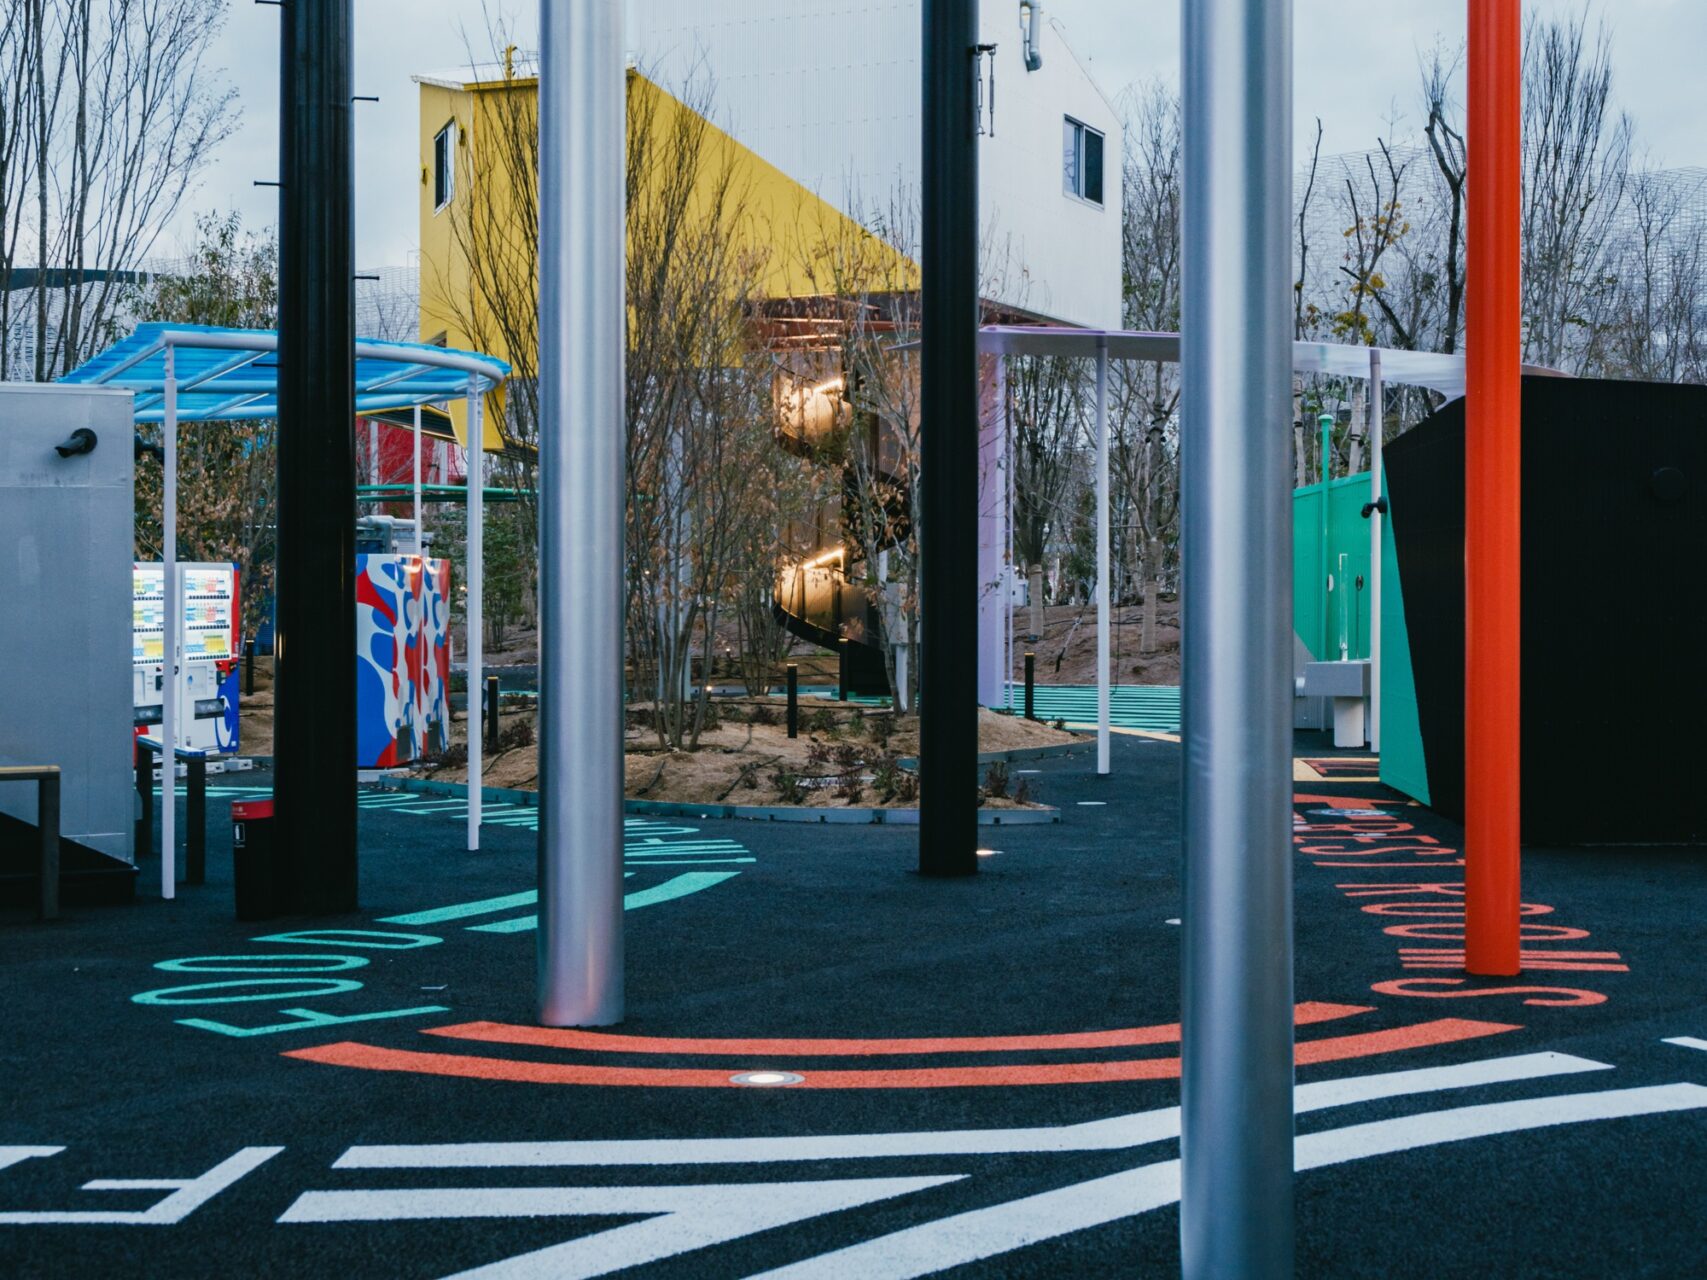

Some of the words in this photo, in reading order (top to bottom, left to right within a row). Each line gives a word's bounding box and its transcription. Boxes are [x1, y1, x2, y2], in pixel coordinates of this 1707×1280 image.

[243, 789, 757, 864] INFOATI
[1293, 822, 1466, 867] REST
[129, 929, 451, 1037] FOOD
[1335, 882, 1630, 1007] ROOMS
